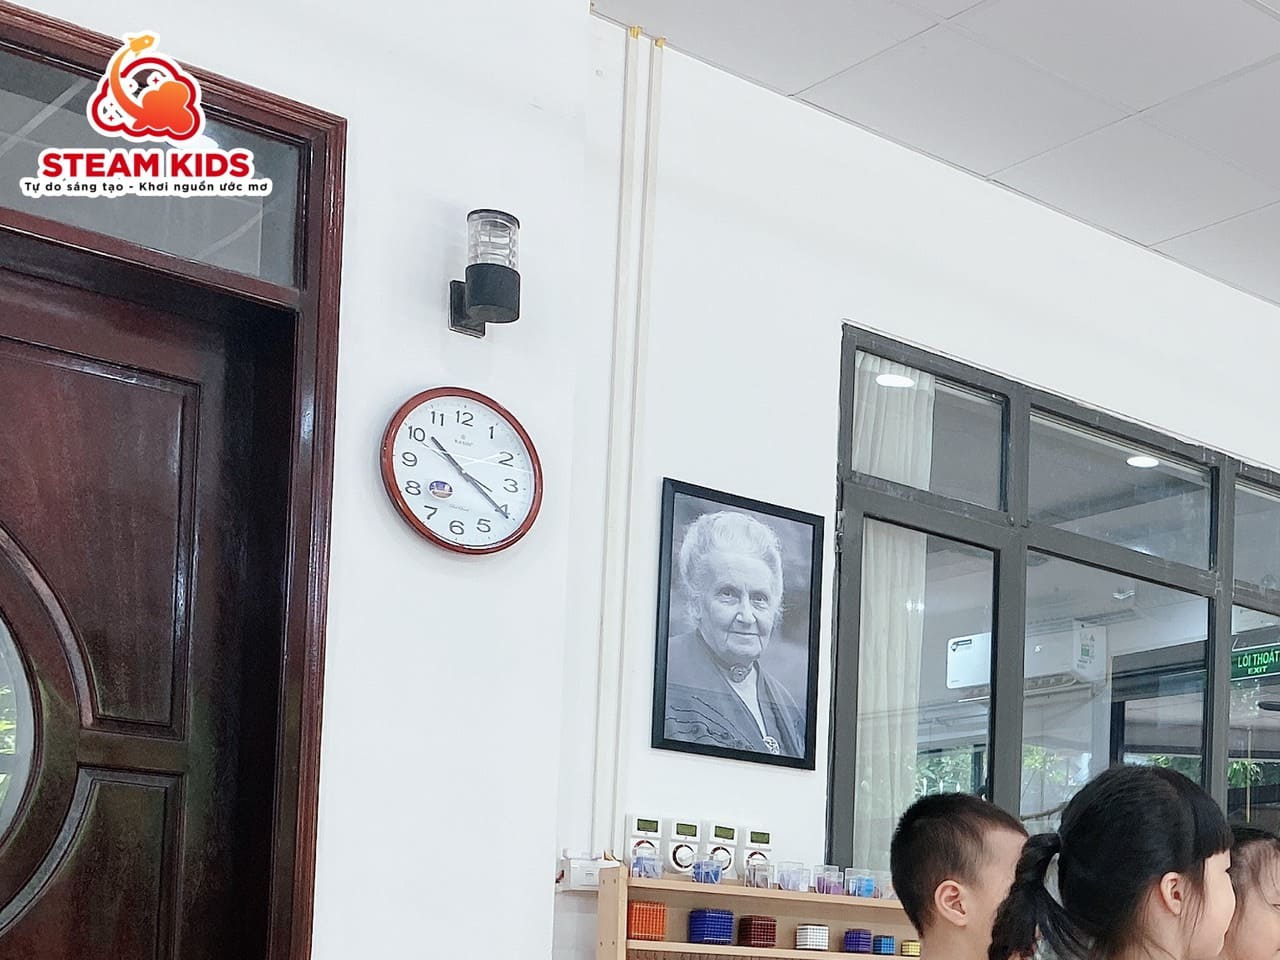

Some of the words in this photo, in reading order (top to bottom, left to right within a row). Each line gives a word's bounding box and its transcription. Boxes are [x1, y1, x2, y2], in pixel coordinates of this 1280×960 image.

[431, 411, 444, 426] 11
[456, 410, 474, 427] 12
[408, 425, 425, 442] 10
[488, 425, 494, 439] 1
[402, 451, 418, 467] 9
[498, 452, 514, 467] 2
[405, 480, 421, 495] 8
[503, 478, 519, 493] 3
[424, 505, 438, 520] 7
[449, 520, 464, 535] 6
[476, 518, 491, 533] 5
[1247, 665, 1268, 674] EXIT
